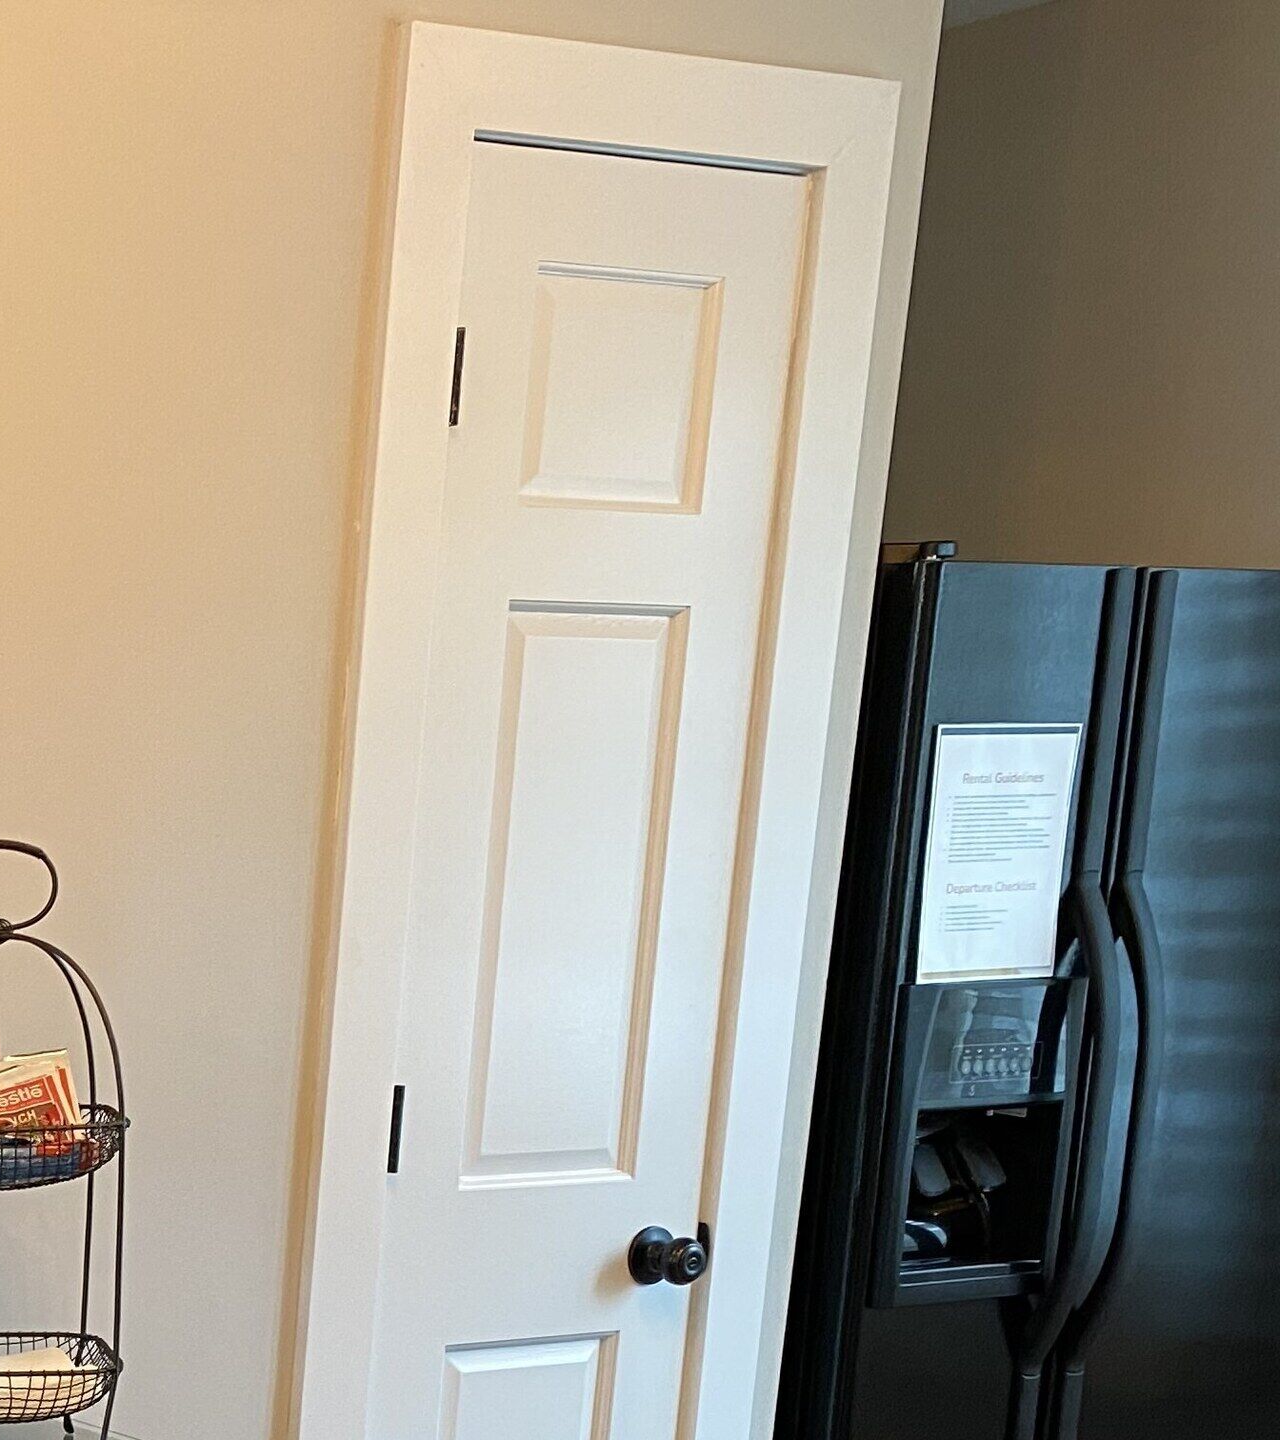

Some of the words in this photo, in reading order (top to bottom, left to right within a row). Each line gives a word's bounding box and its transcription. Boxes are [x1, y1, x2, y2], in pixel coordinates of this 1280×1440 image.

[962, 772, 992, 784] Rental
[995, 772, 1045, 783] Guidelines
[946, 882, 993, 894] Departure
[995, 880, 1037, 891] Checklist
